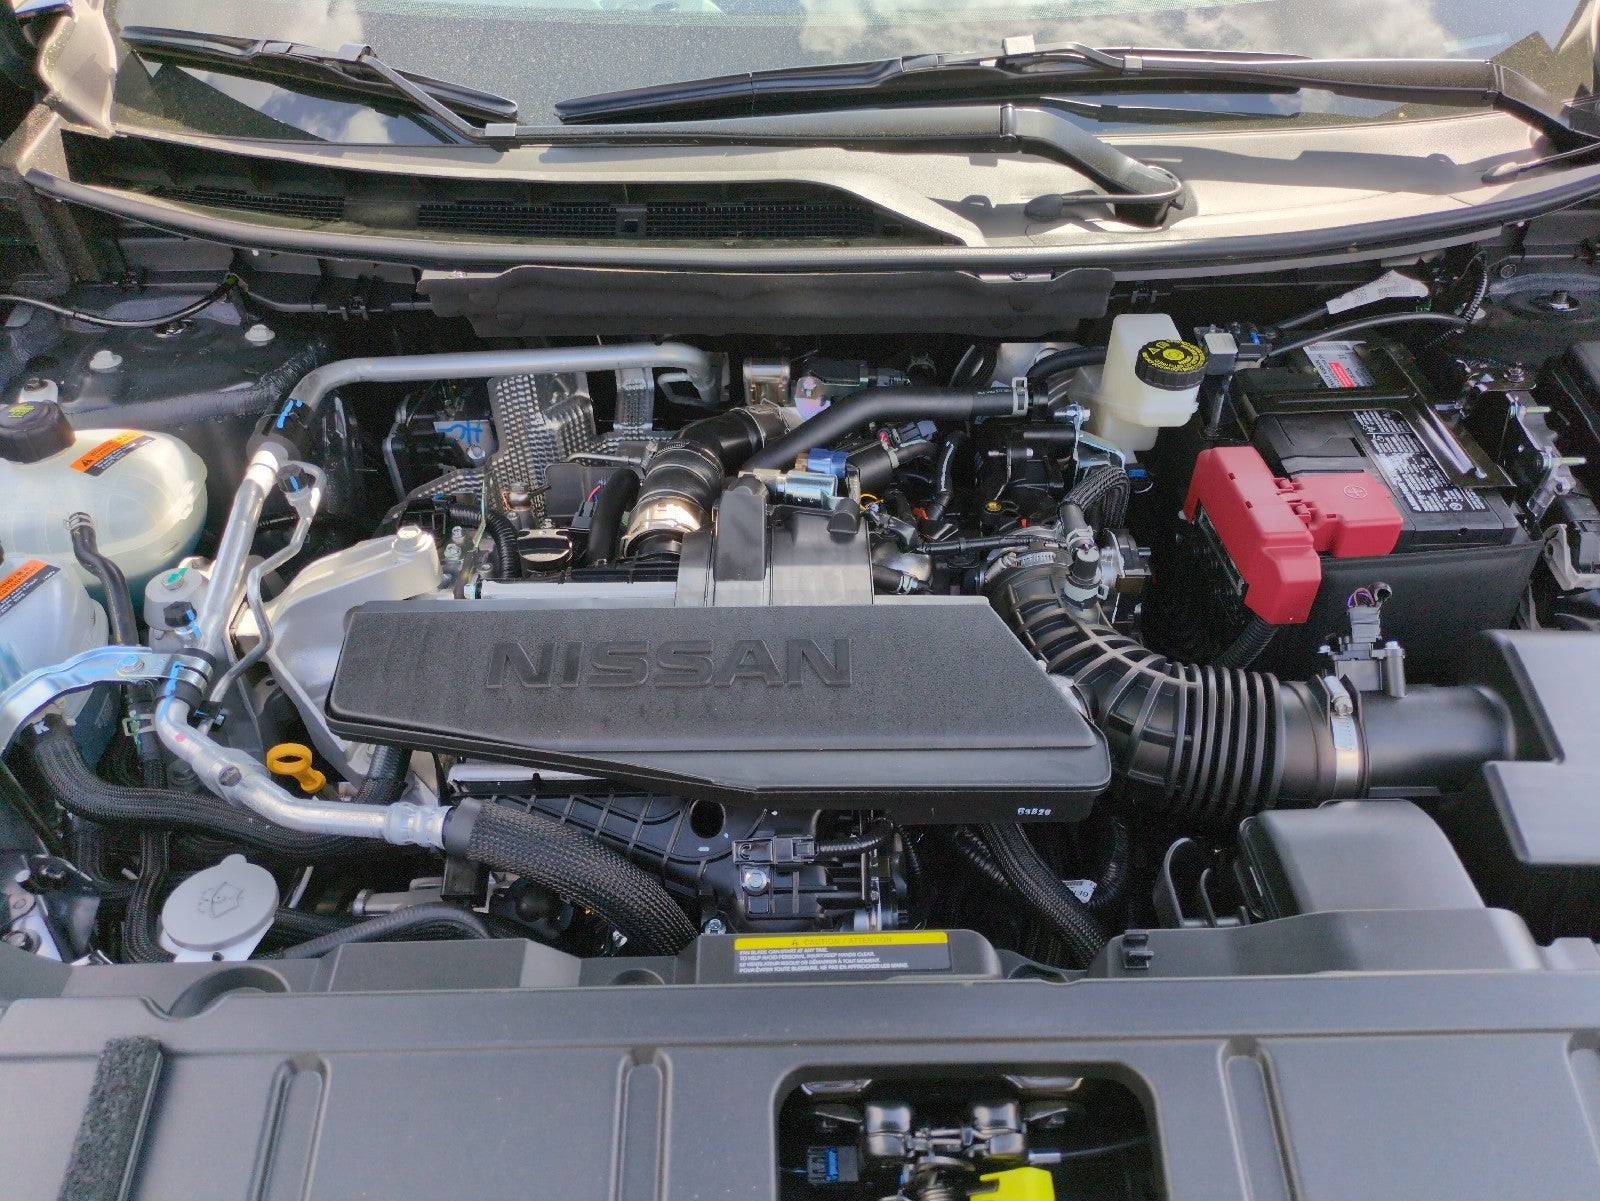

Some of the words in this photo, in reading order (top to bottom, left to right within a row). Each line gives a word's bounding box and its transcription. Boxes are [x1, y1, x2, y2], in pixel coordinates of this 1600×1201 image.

[484, 638, 852, 689] NISSAN
[33, 721, 50, 735] K
[804, 938, 840, 946] CAUTION
[849, 936, 892, 944] ATTENTION
